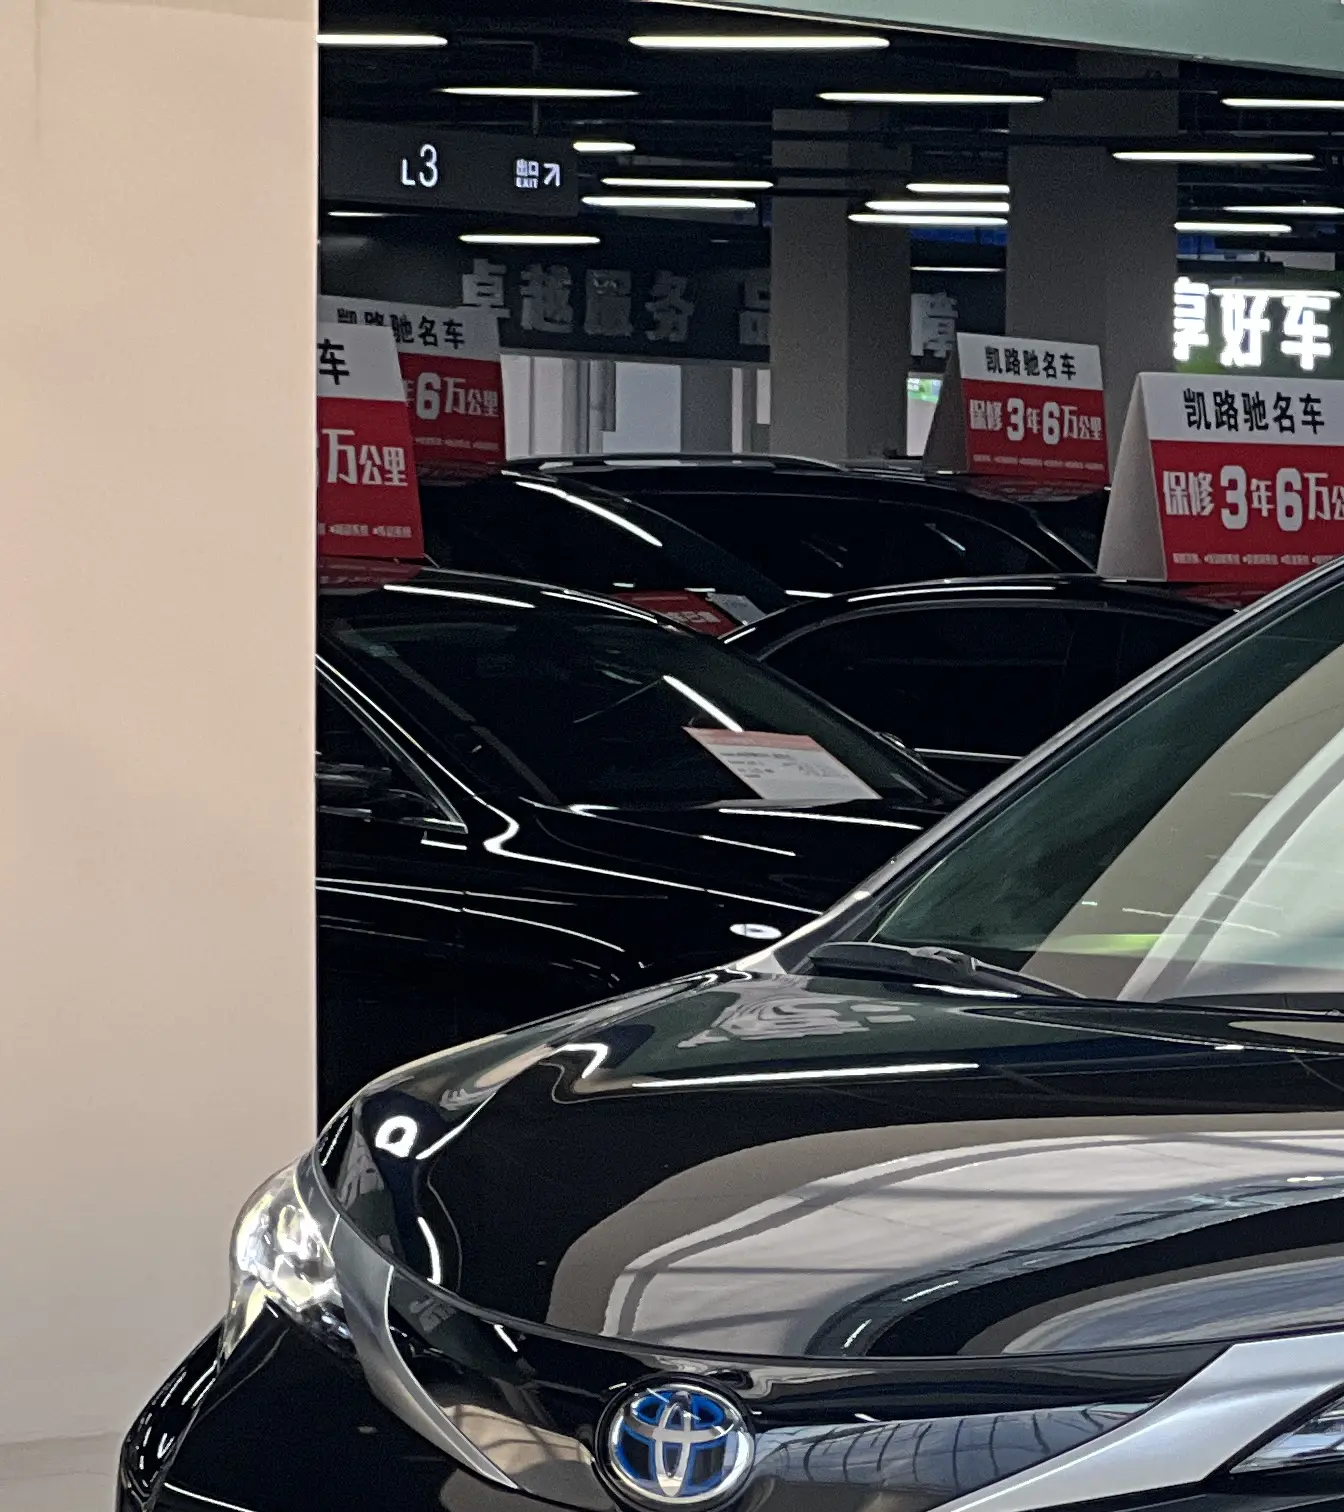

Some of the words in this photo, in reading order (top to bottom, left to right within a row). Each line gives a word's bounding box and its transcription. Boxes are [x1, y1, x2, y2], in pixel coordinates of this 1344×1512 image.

[402, 144, 438, 187] L3
[516, 177, 538, 188] EXIT
[985, 345, 1076, 381] 凯路驰名车
[969, 397, 1102, 445] 保修3年6万公里
[1183, 388, 1325, 435] 凯路驰名车
